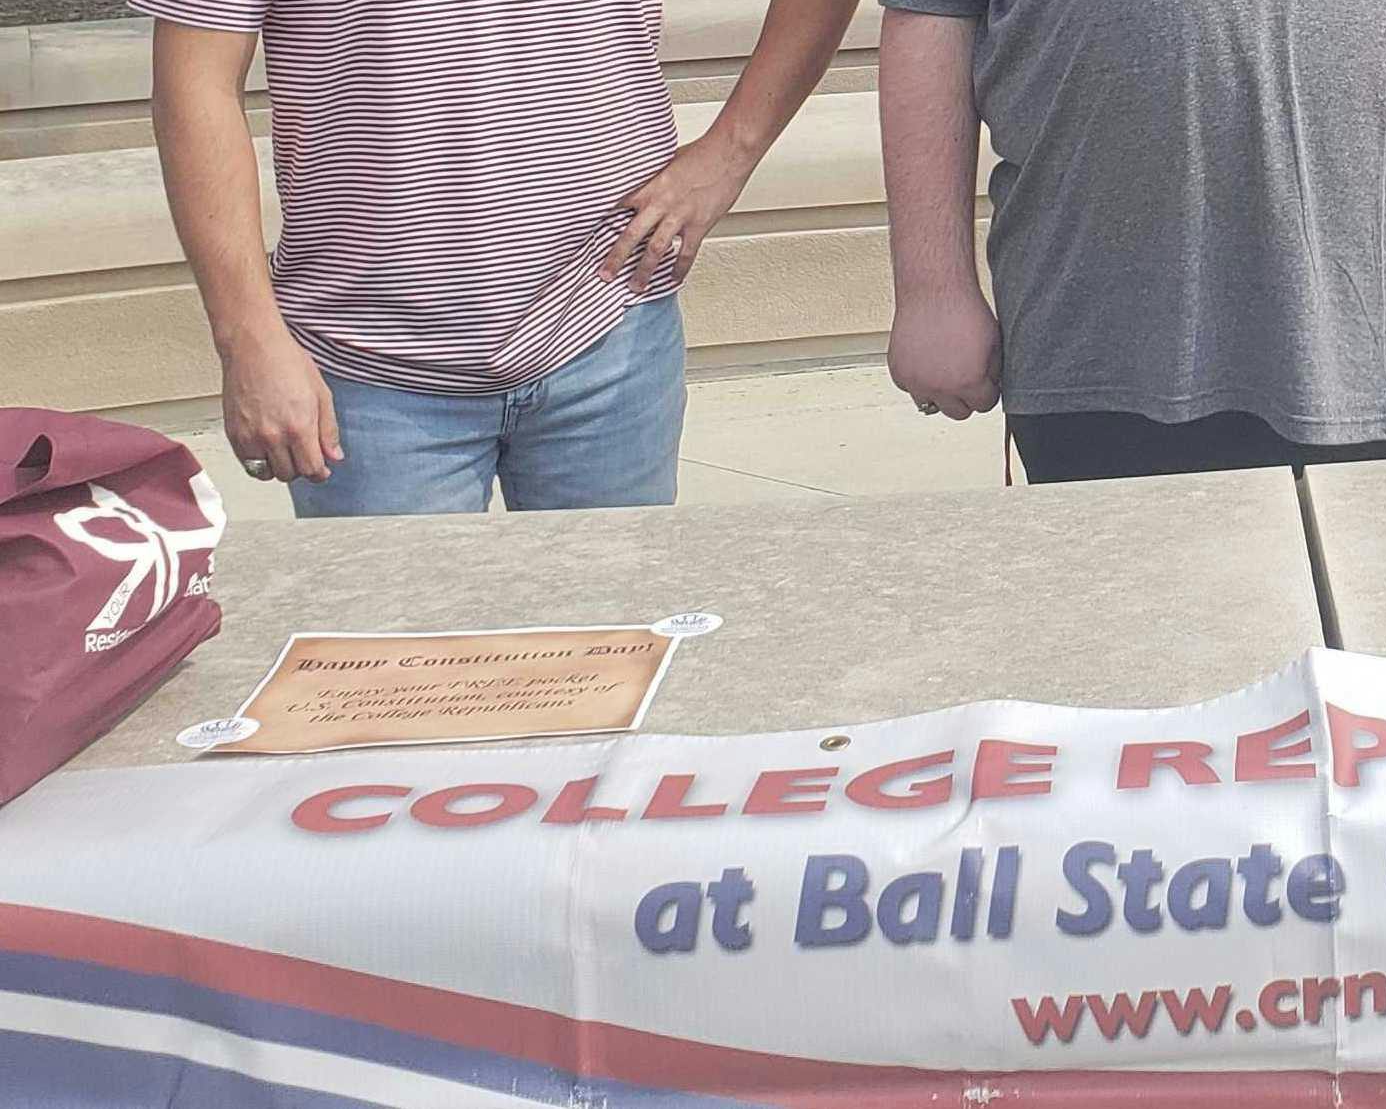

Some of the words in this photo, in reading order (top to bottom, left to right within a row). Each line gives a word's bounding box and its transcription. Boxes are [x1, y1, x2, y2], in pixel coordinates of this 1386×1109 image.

[294, 657, 389, 674] Happy
[398, 647, 573, 669] Constitution
[583, 641, 655, 657] Day!
[350, 706, 435, 723] College
[438, 697, 577, 718] Republicans
[290, 739, 1059, 834] COLLEGE
[633, 867, 754, 954] at
[794, 844, 1020, 949] Ball
[1054, 840, 1344, 936] State
